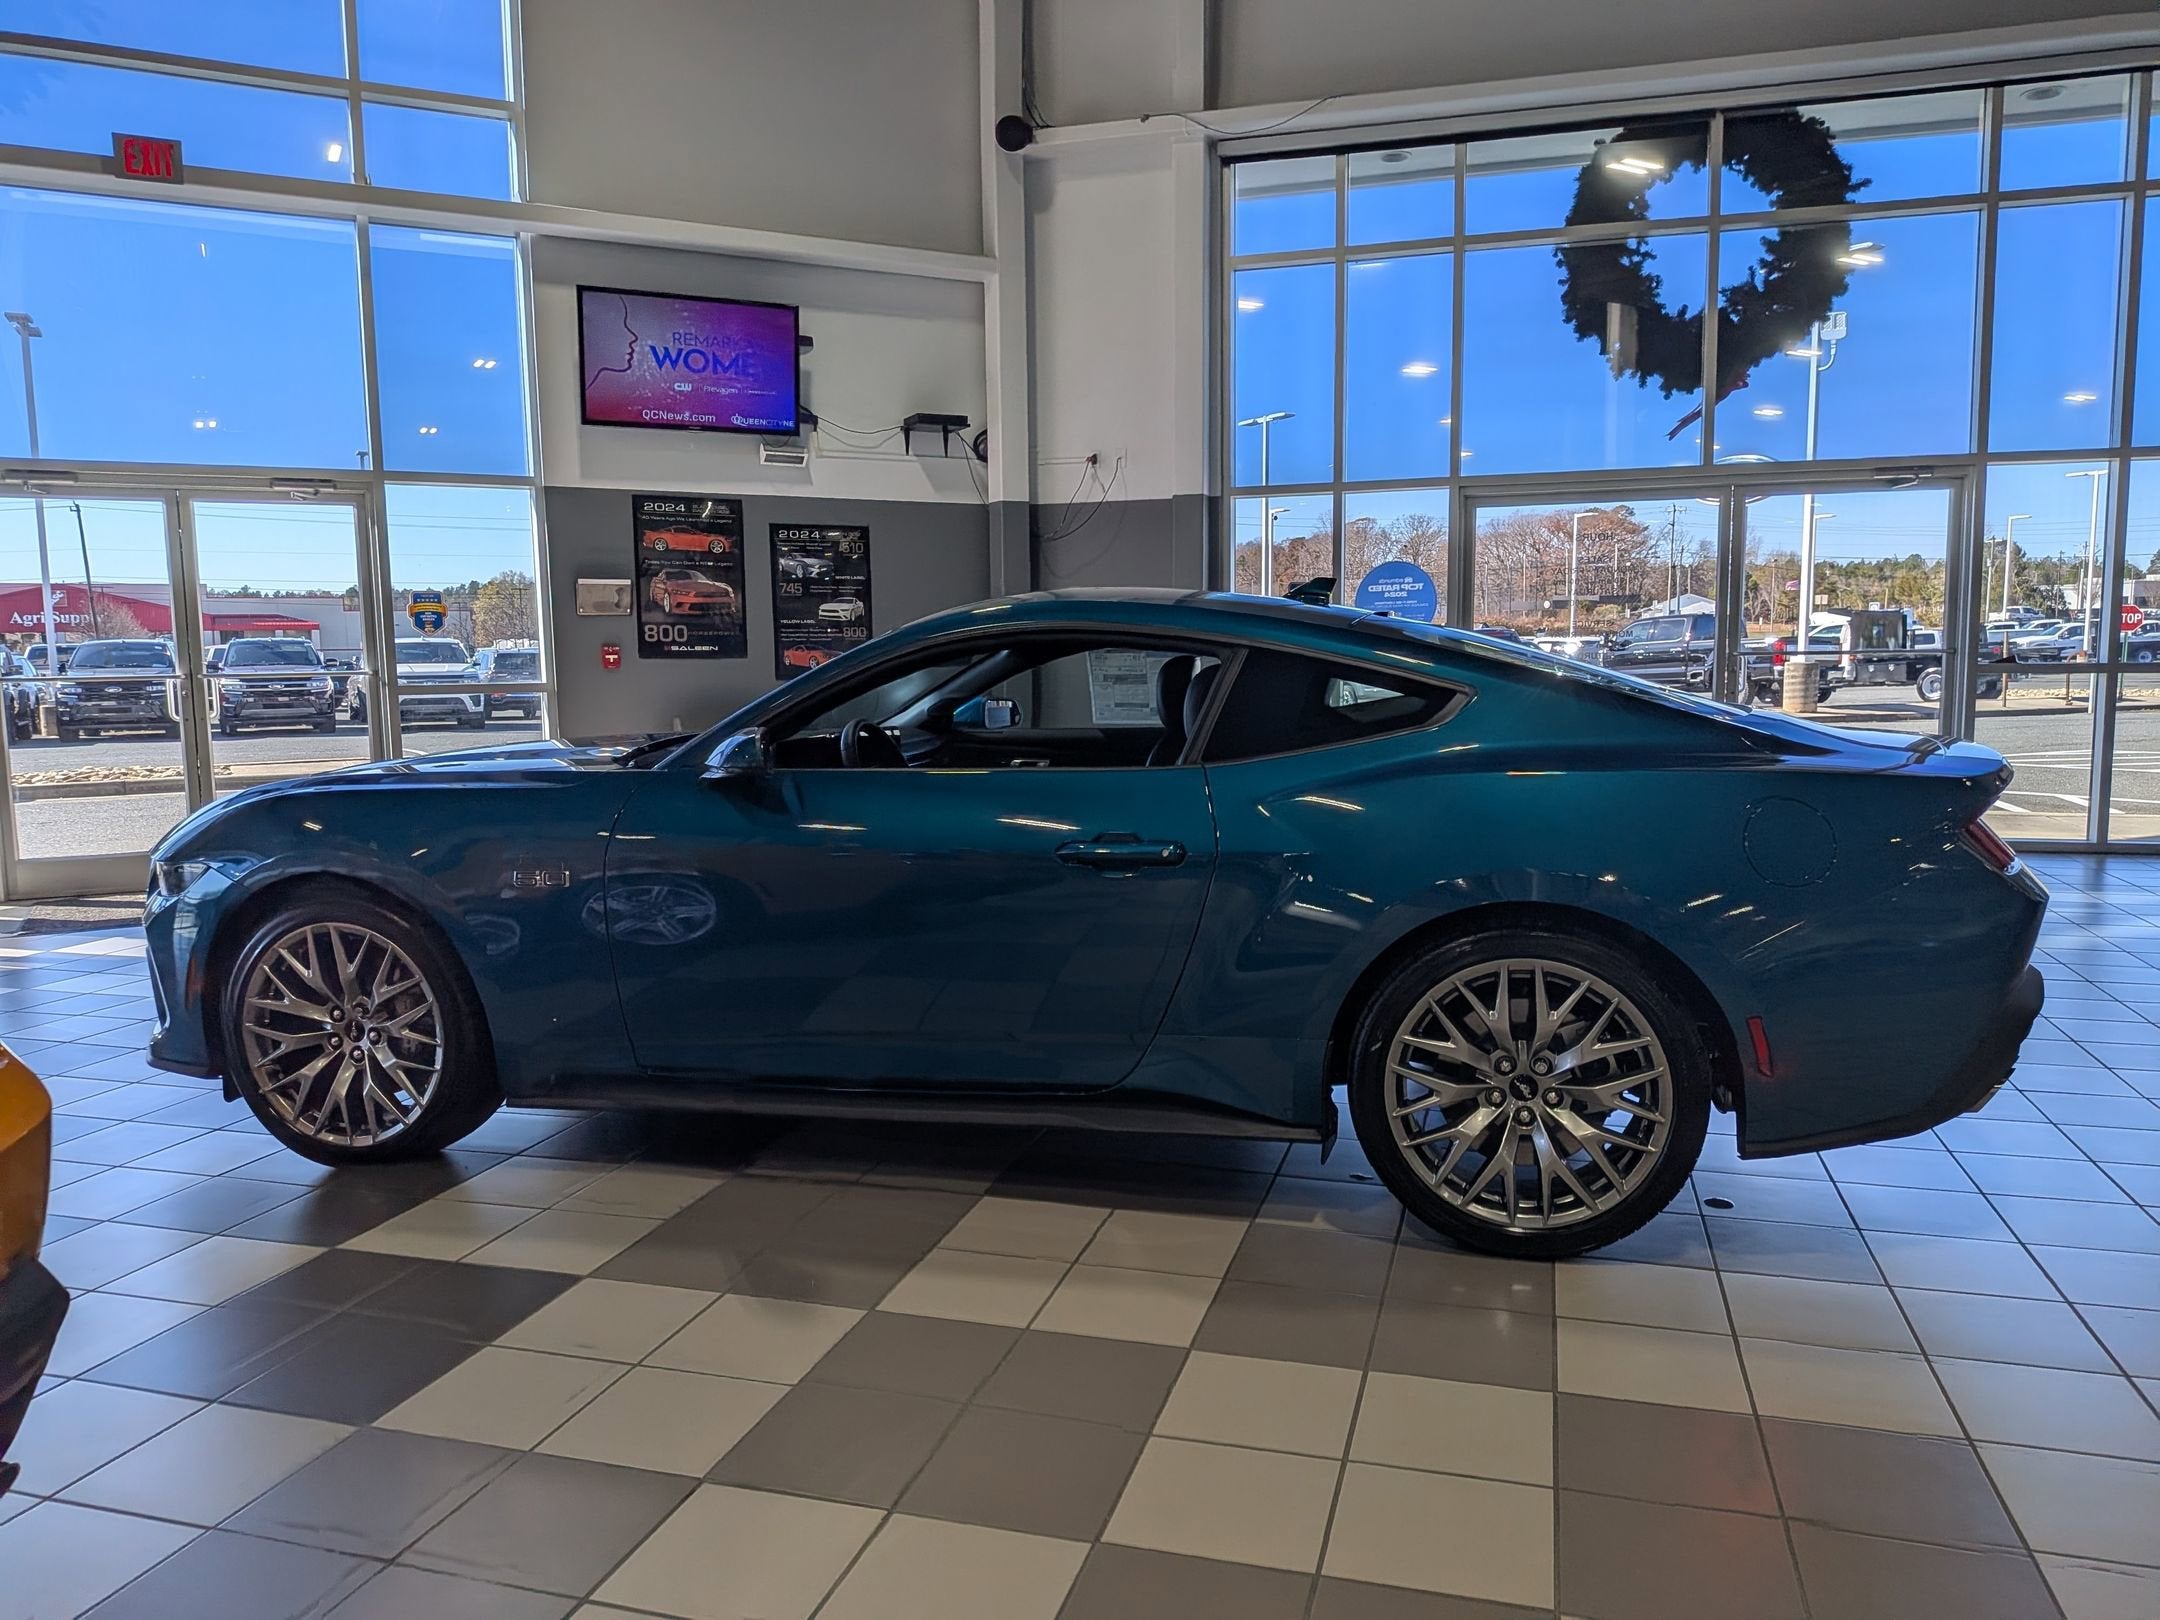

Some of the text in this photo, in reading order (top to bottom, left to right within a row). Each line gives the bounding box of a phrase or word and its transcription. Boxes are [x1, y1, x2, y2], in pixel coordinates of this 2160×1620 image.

[124, 138, 172, 177] EXIT
[674, 382, 692, 391] CW
[703, 385, 738, 395] Prevagen
[642, 409, 716, 423] QCNews.com
[644, 502, 685, 512] 2024
[778, 530, 820, 539] 2024
[842, 542, 864, 553] 510
[779, 582, 803, 594] 745
[9, 611, 45, 627] Agri
[2121, 613, 2142, 624] TOP
[644, 624, 688, 642] 800
[843, 626, 866, 638] 800
